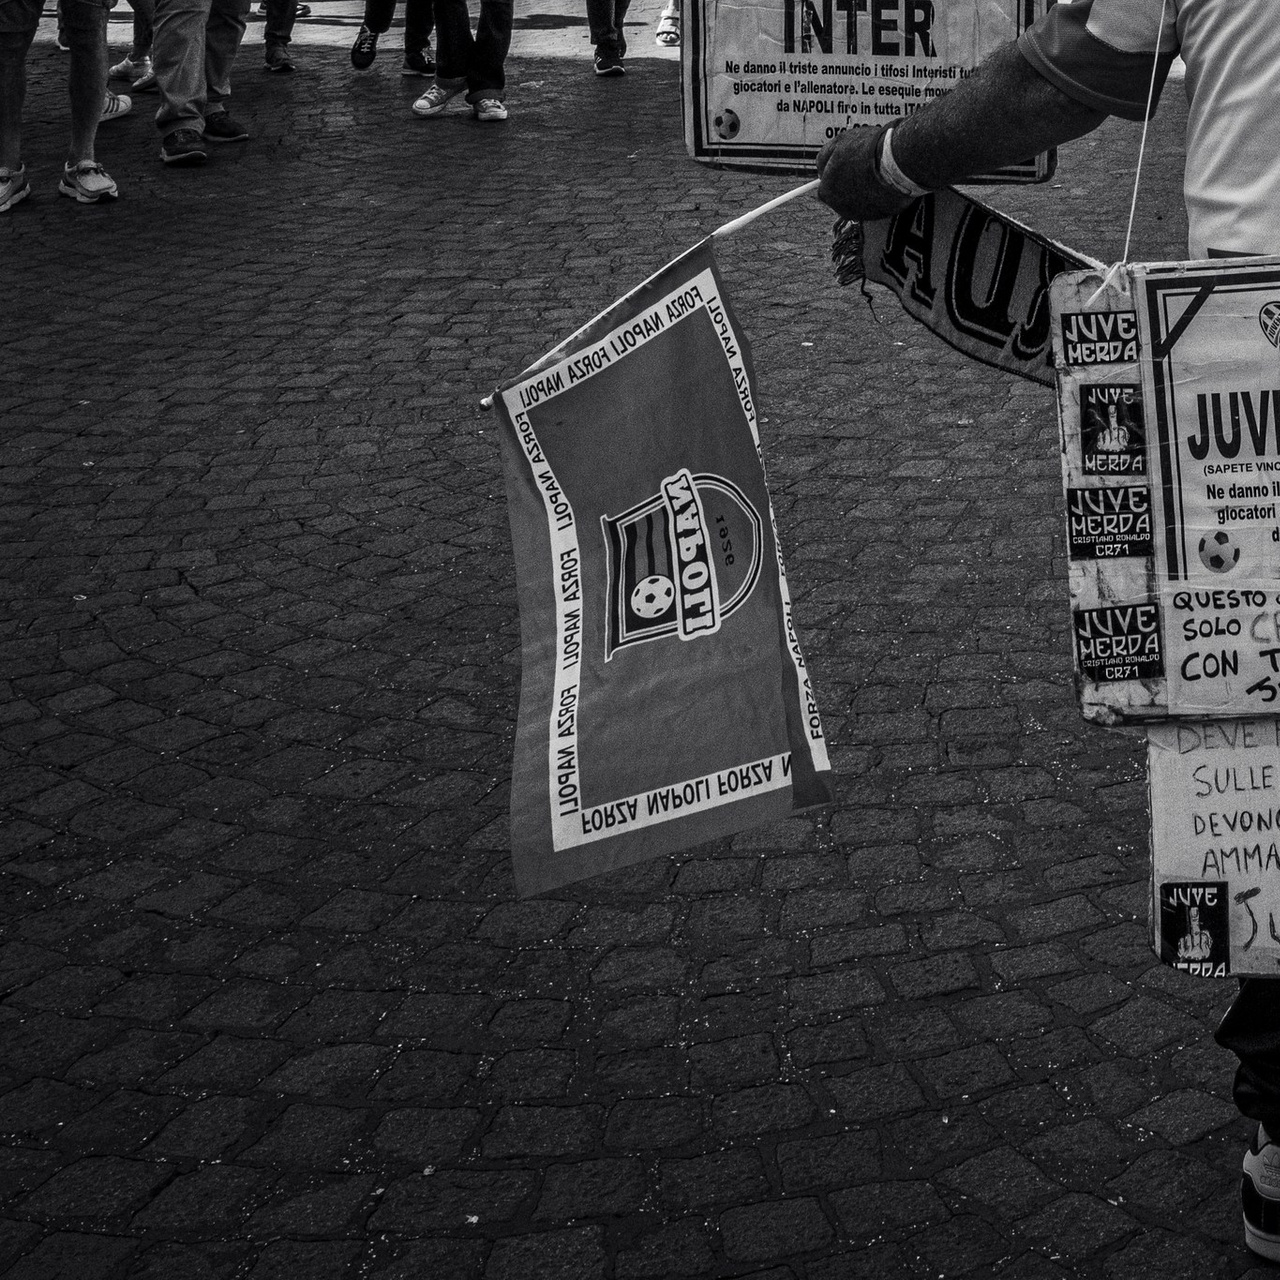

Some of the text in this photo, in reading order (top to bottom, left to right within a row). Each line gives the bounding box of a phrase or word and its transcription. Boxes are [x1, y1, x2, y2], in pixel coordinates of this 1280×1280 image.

[725, 60, 740, 74] Ne
[743, 61, 776, 74] danno
[779, 62, 786, 74] il
[790, 62, 818, 76] triste
[822, 63, 872, 78] annuncio
[874, 64, 878, 76] i
[881, 65, 909, 78] tifosi
[912, 65, 956, 79] Interisti
[733, 80, 782, 96] giocatori
[784, 82, 791, 93] e
[862, 82, 876, 96] Le
[878, 84, 922, 99] esequie
[776, 100, 901, 115] da NAPOLI in tutta
[1066, 313, 1136, 342] JUVE
[1068, 340, 1138, 364] MERDA
[1088, 388, 1134, 405] JUVE
[1085, 454, 1143, 472] MERDA
[1204, 462, 1253, 477] (SAPETE
[1206, 483, 1225, 500] Ne
[1228, 483, 1269, 500] danno
[1272, 481, 1280, 496] il
[1071, 488, 1148, 516] JUVE
[1218, 504, 1276, 524] giocatori
[1072, 514, 1150, 536] MERDA
[1072, 533, 1150, 544] CRISTIANO RONALDO
[1096, 544, 1130, 556] CR71
[1172, 590, 1268, 611] QUESTO
[1079, 606, 1156, 638] JUVE
[1183, 618, 1242, 642] SOLO
[1080, 633, 1160, 660] MERDA
[1082, 654, 1160, 668] CRISTIANO RONALDO
[1180, 652, 1240, 682] CON
[786, 602, 823, 741] FORZA NAPOLI
[1105, 666, 1140, 679] CR71
[1176, 719, 1256, 754] DEVE
[1192, 764, 1274, 798] SULLE
[1170, 888, 1218, 906] JUVE
